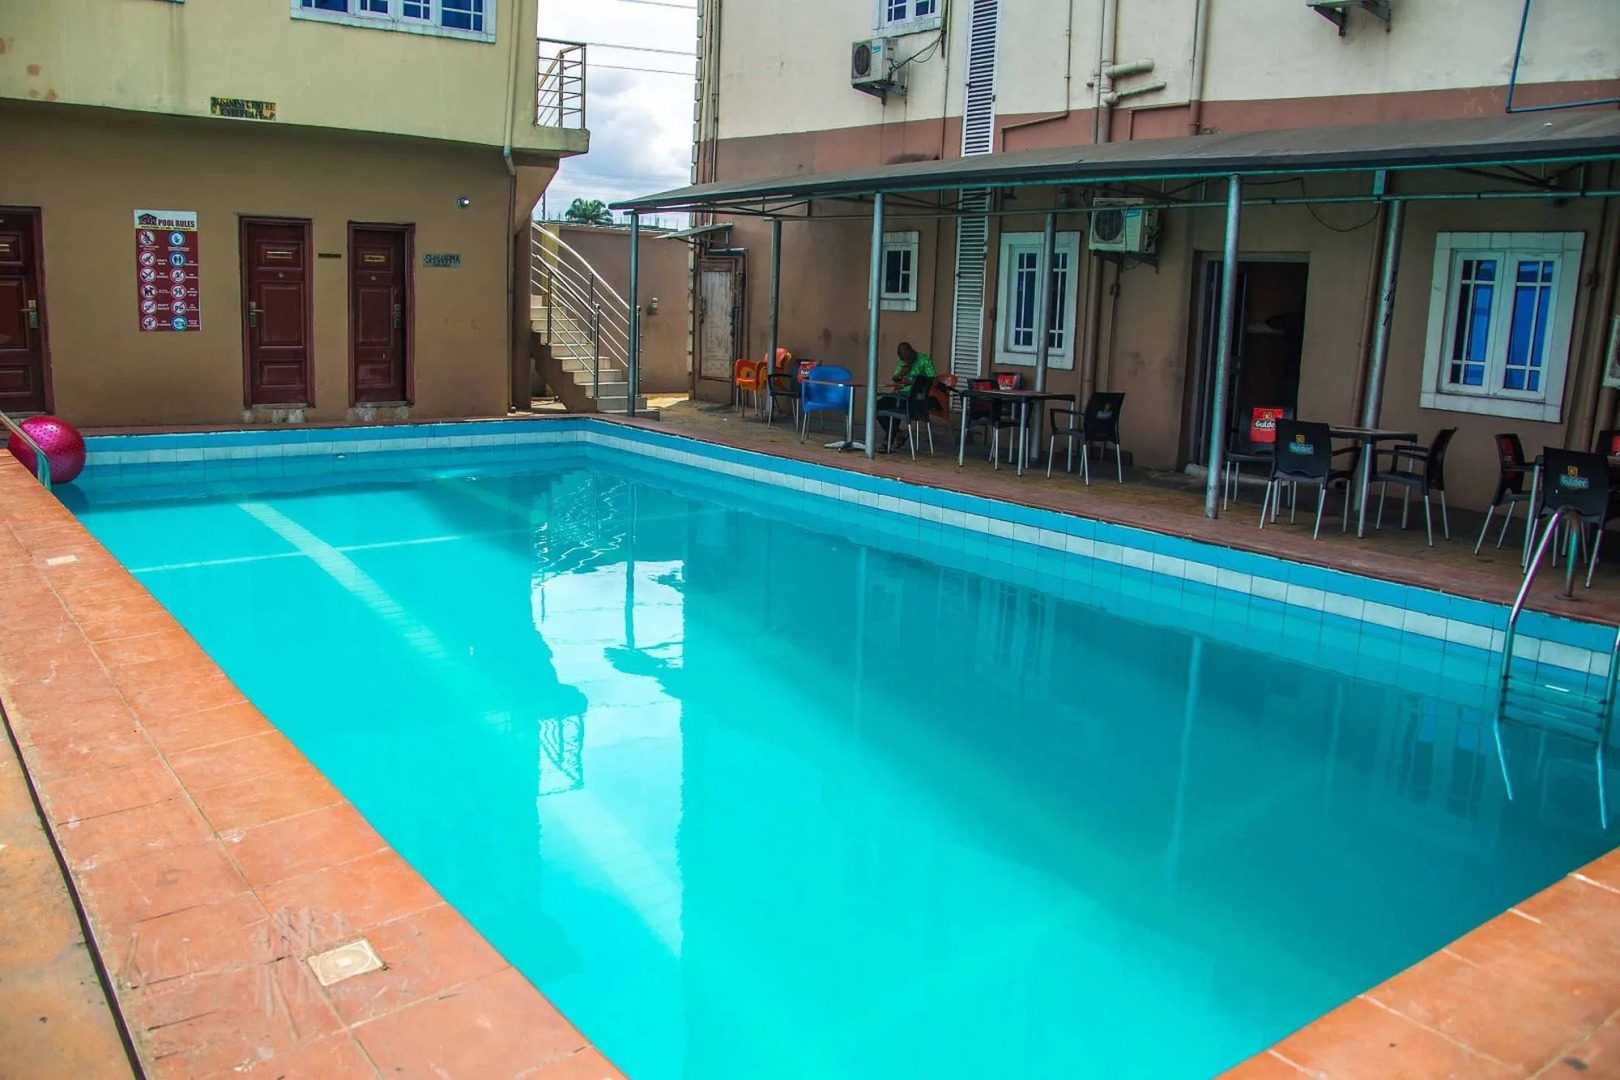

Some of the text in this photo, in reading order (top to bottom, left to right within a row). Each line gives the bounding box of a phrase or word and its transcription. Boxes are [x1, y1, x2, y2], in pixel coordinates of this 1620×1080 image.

[158, 219, 175, 227] POOL
[176, 220, 195, 228] RULES
[1255, 420, 1276, 429] Gulde
